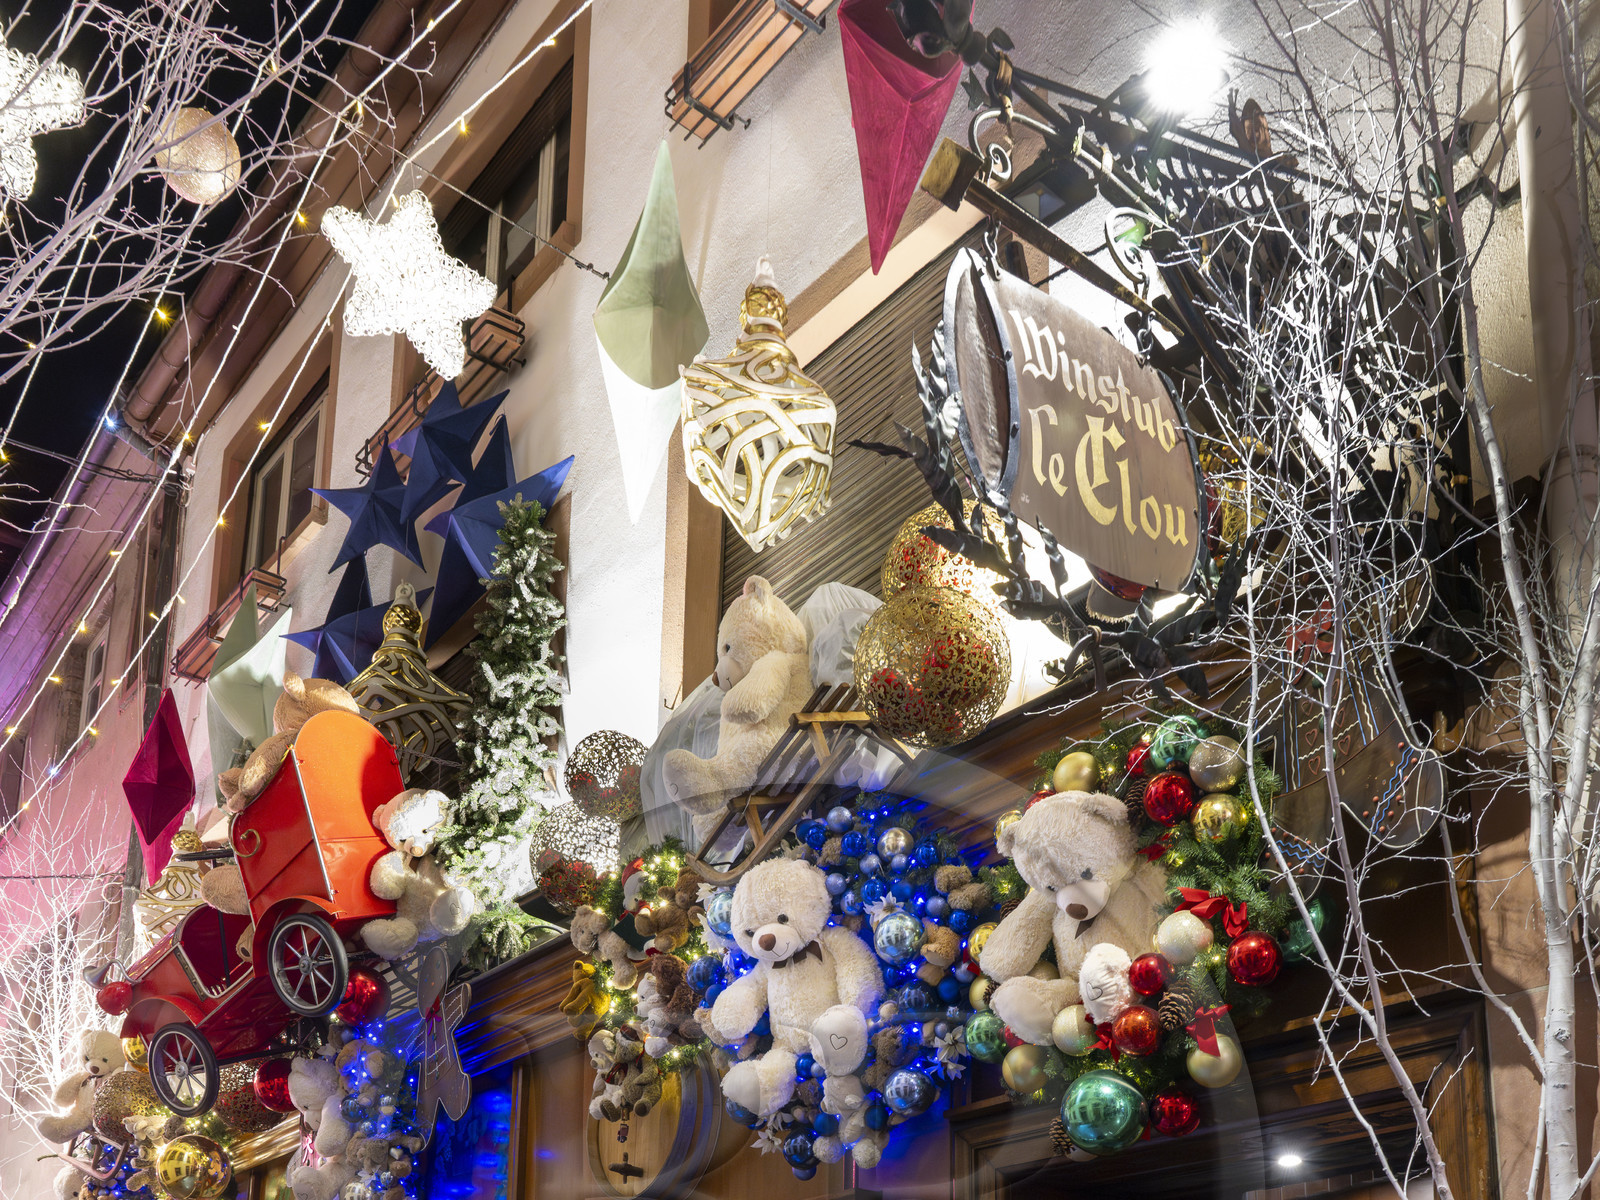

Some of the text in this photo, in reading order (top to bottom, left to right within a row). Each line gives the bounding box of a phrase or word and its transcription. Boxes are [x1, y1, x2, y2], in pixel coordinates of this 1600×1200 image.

[1008, 309, 1175, 453] Winstub
[1028, 404, 1190, 547] Le Clou
